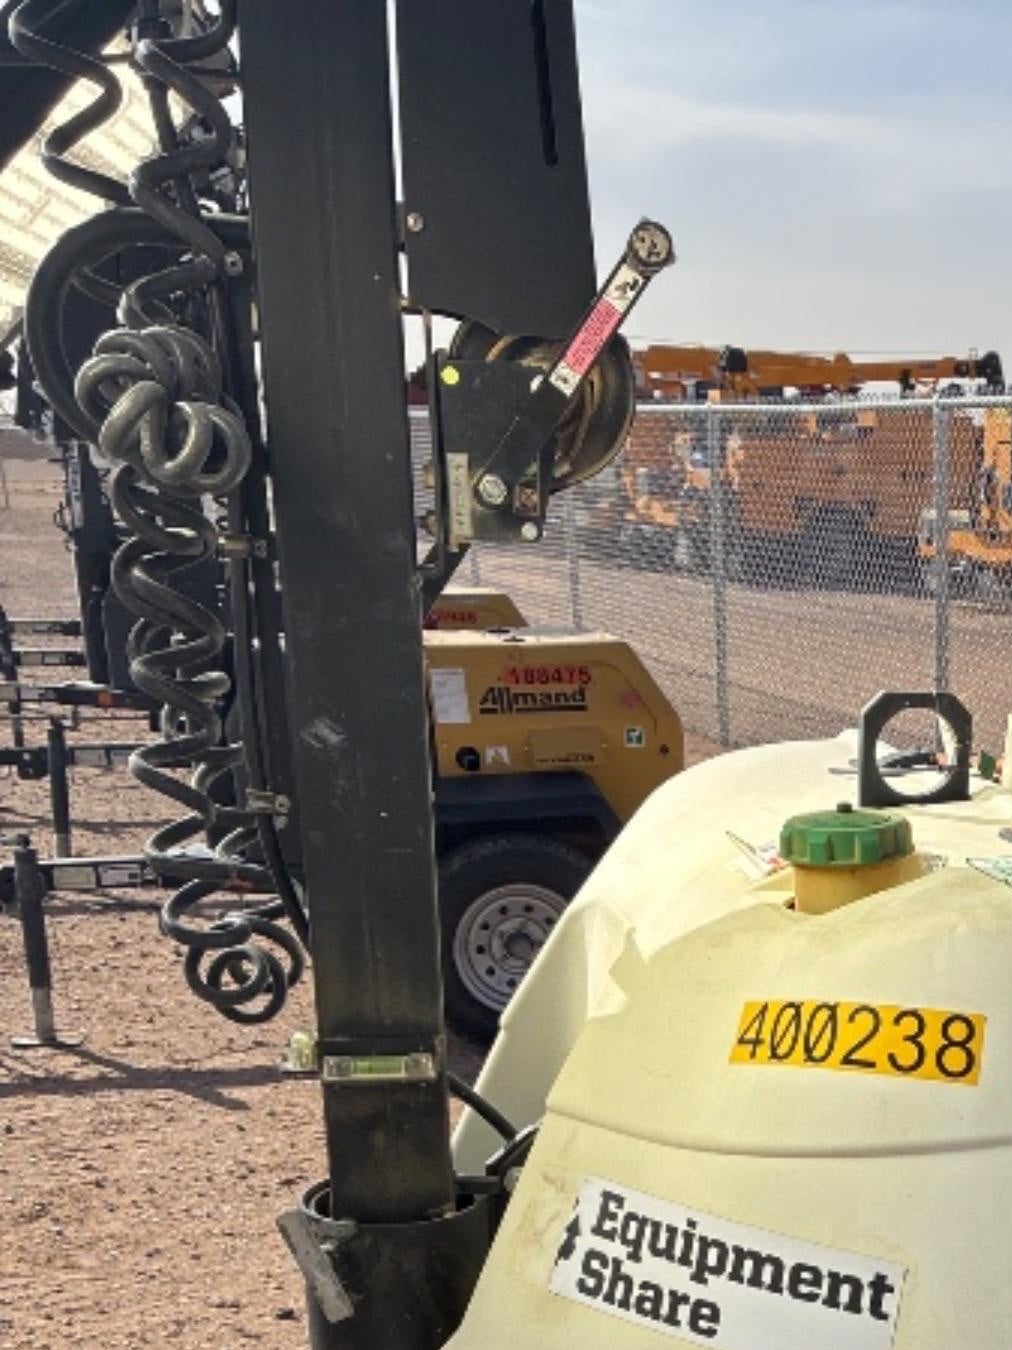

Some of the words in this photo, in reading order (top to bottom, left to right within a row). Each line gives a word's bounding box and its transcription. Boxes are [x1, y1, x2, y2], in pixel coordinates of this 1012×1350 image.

[479, 686, 588, 715] Allmand
[738, 1001, 976, 1078] 400238
[577, 1248, 721, 1338] Share
[590, 1189, 895, 1321] Equipment
